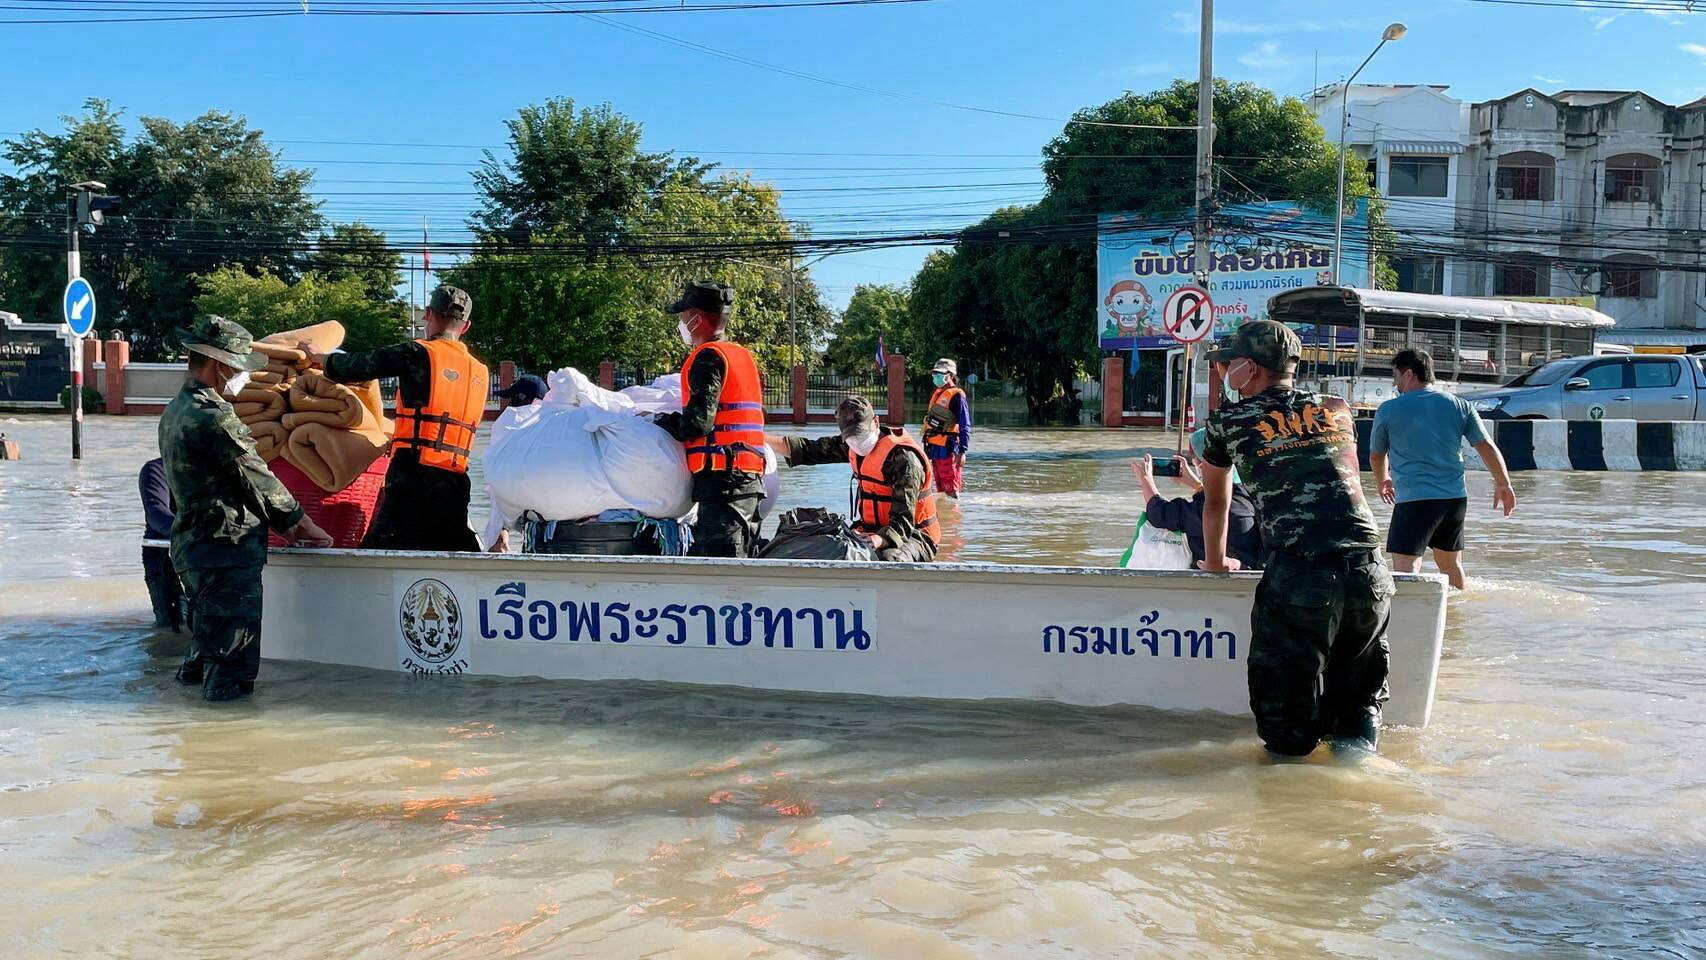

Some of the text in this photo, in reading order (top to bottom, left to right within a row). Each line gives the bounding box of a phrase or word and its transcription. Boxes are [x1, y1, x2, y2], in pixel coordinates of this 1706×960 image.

[1221, 275, 1303, 291] สวมหมวกนิรภัย
[0, 341, 41, 360] สุโขทัย
[478, 582, 872, 651] เรือพระราชทาน
[1042, 610, 1236, 660] กรมเจ้าท่า
